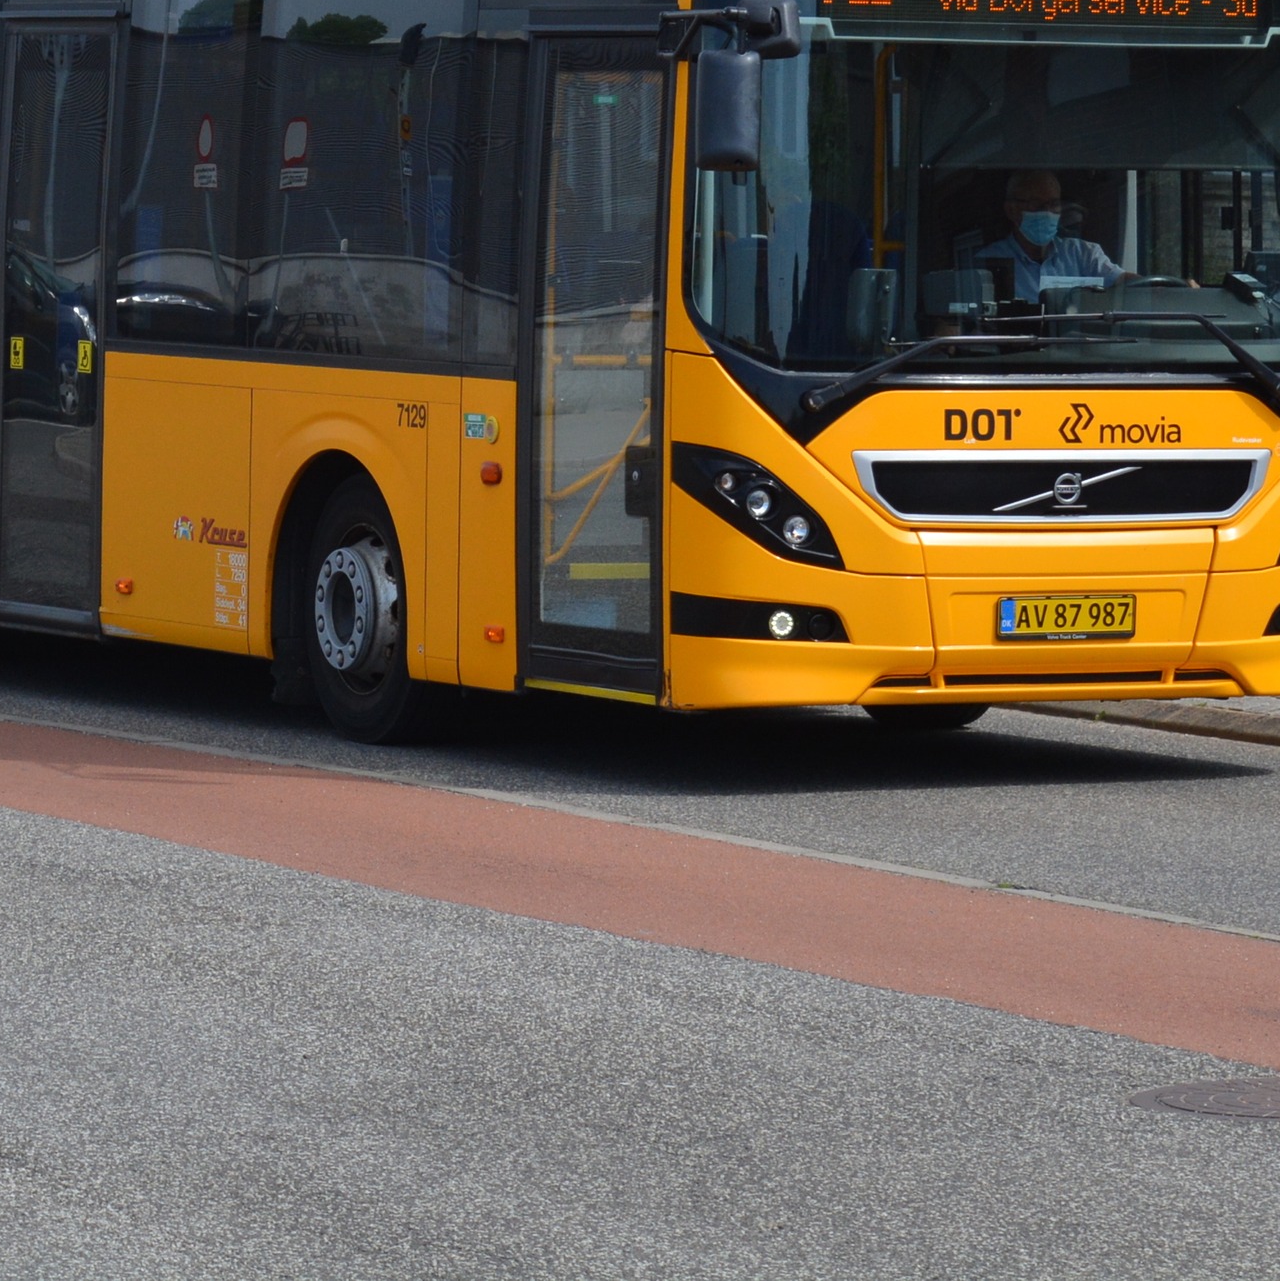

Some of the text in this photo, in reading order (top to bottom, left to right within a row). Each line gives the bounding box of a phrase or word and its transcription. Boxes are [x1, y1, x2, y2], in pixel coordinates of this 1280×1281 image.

[397, 403, 426, 429] 7129
[944, 408, 1013, 441] DOT
[1099, 416, 1182, 444] movia
[198, 517, 248, 548] Kruse
[1001, 619, 1012, 628] DK
[1016, 602, 1131, 628] AV 87 987
